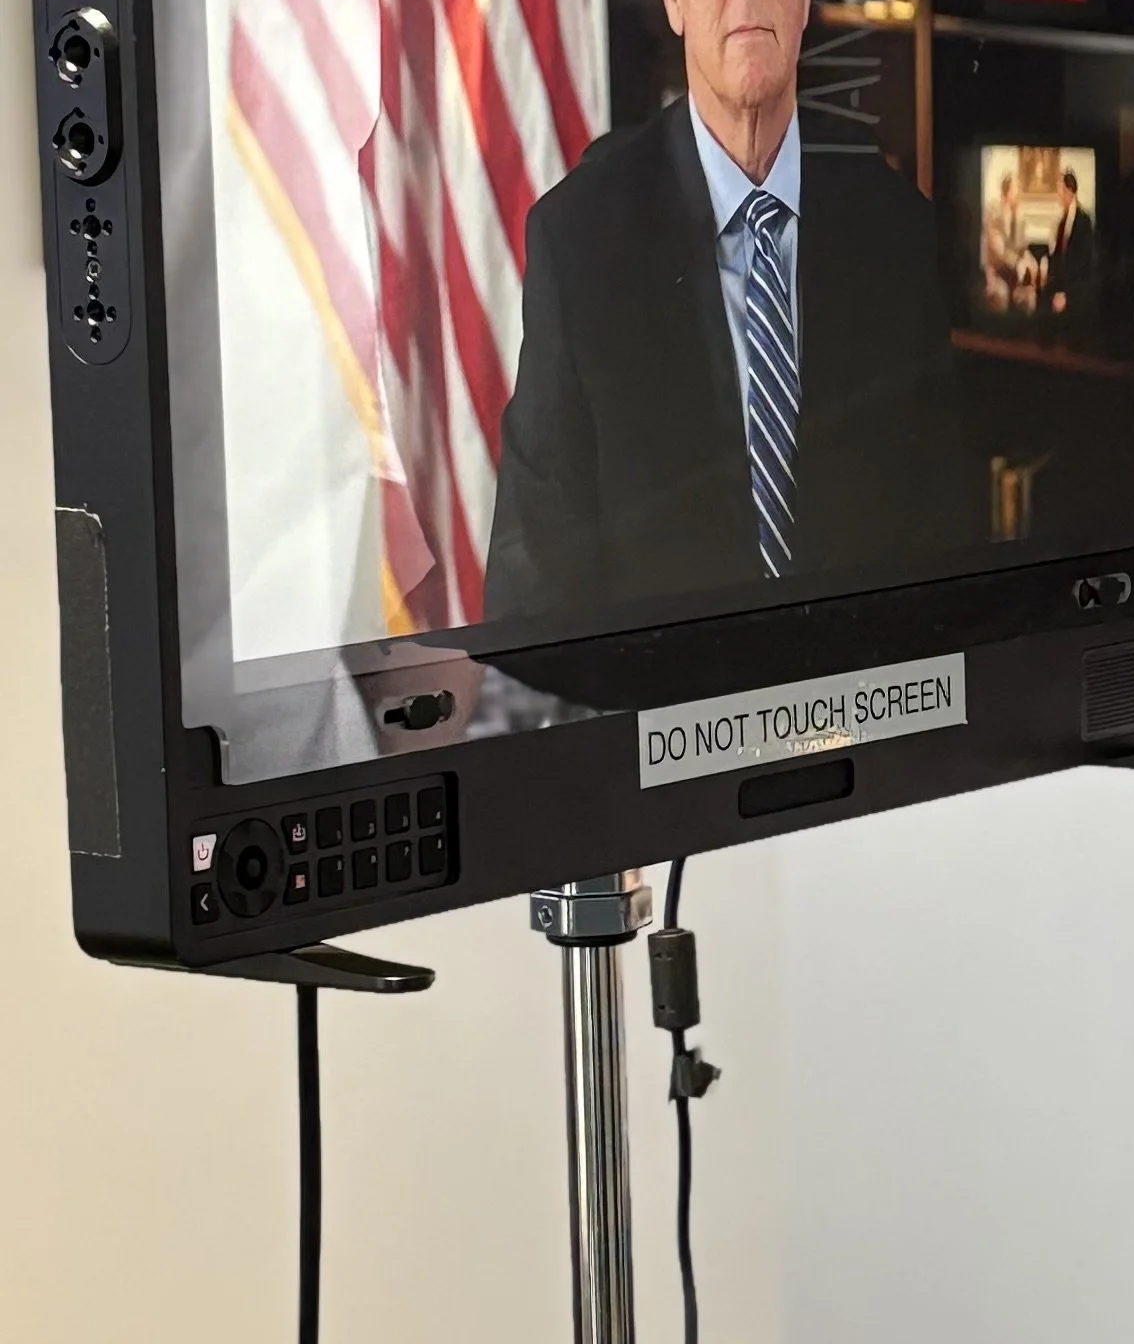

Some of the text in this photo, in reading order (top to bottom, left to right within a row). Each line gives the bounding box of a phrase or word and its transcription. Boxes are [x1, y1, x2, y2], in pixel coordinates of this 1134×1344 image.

[648, 675, 951, 766] DO NOT TOUCH SCREEN
